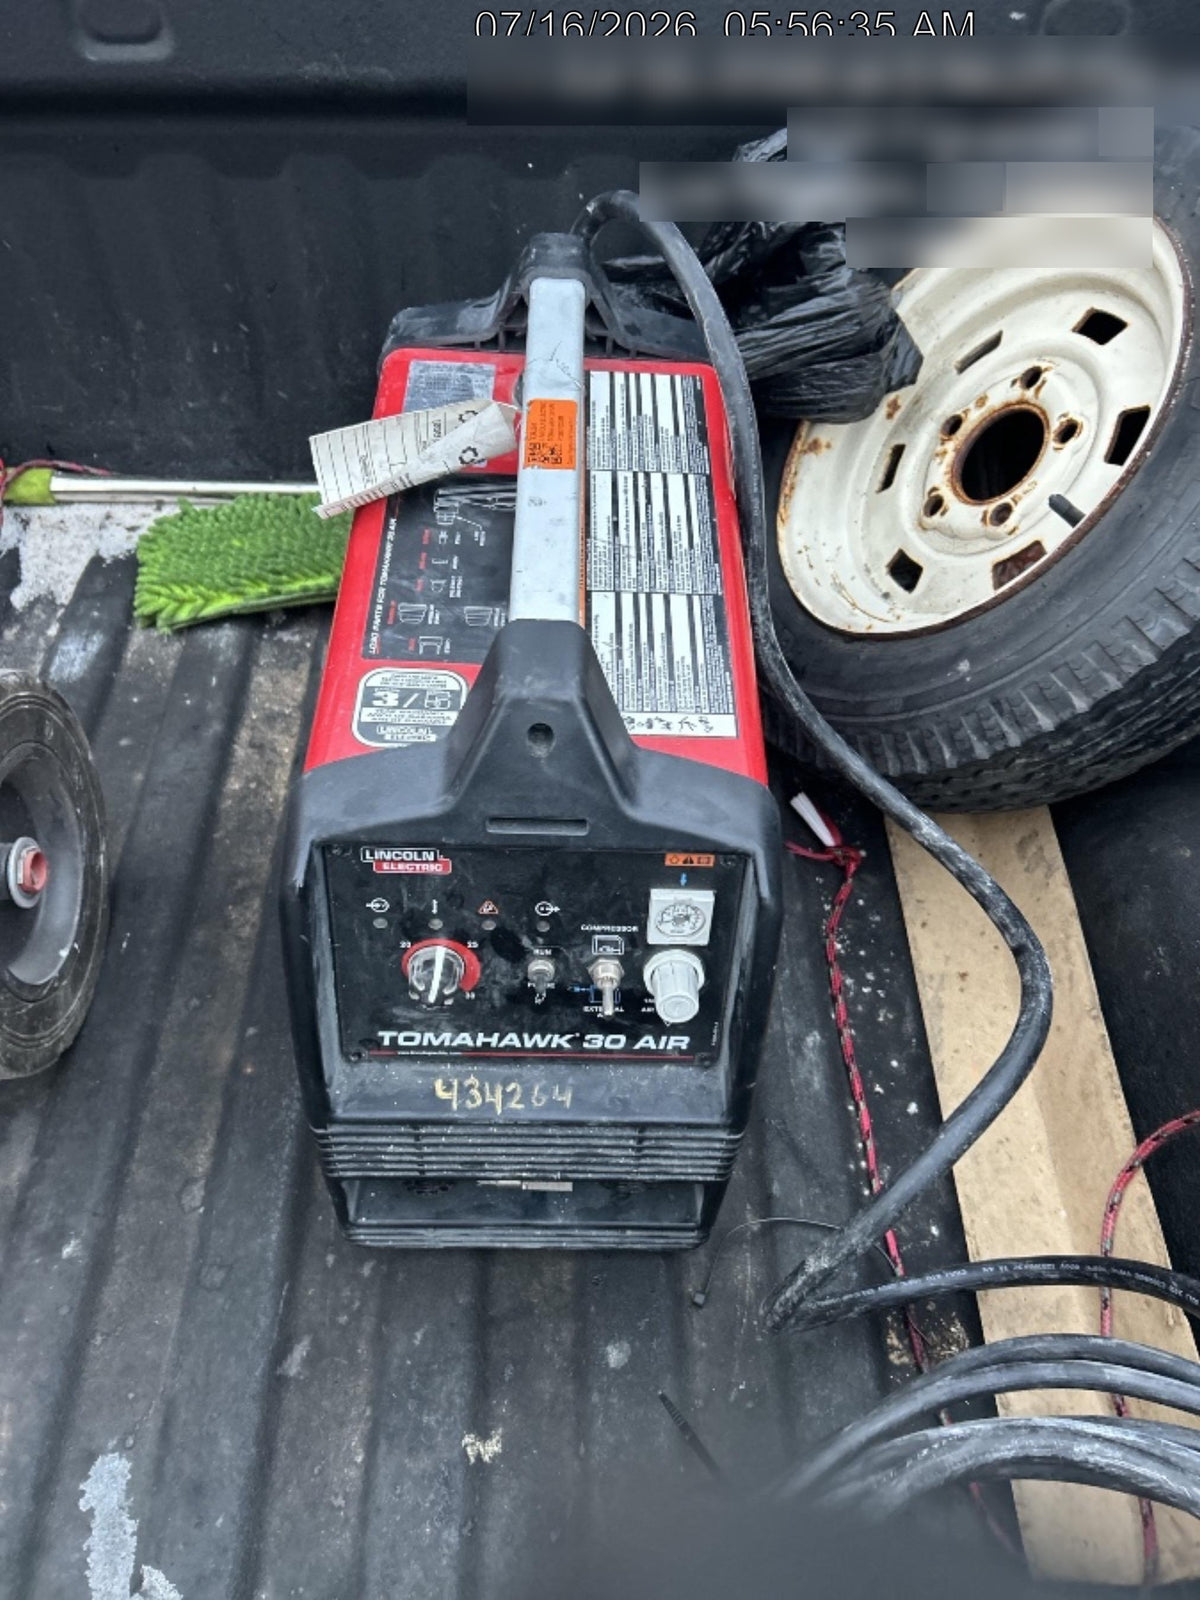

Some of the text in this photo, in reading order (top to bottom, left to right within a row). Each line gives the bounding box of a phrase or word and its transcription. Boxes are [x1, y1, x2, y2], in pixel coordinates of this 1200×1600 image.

[366, 850, 434, 861] LINCOLN
[382, 863, 443, 872] ELECTRIC
[581, 924, 639, 932] COMPRESSOR
[378, 1031, 690, 1050] TOMAHAWK 30 AIR
[434, 1073, 573, 1115] 434264
